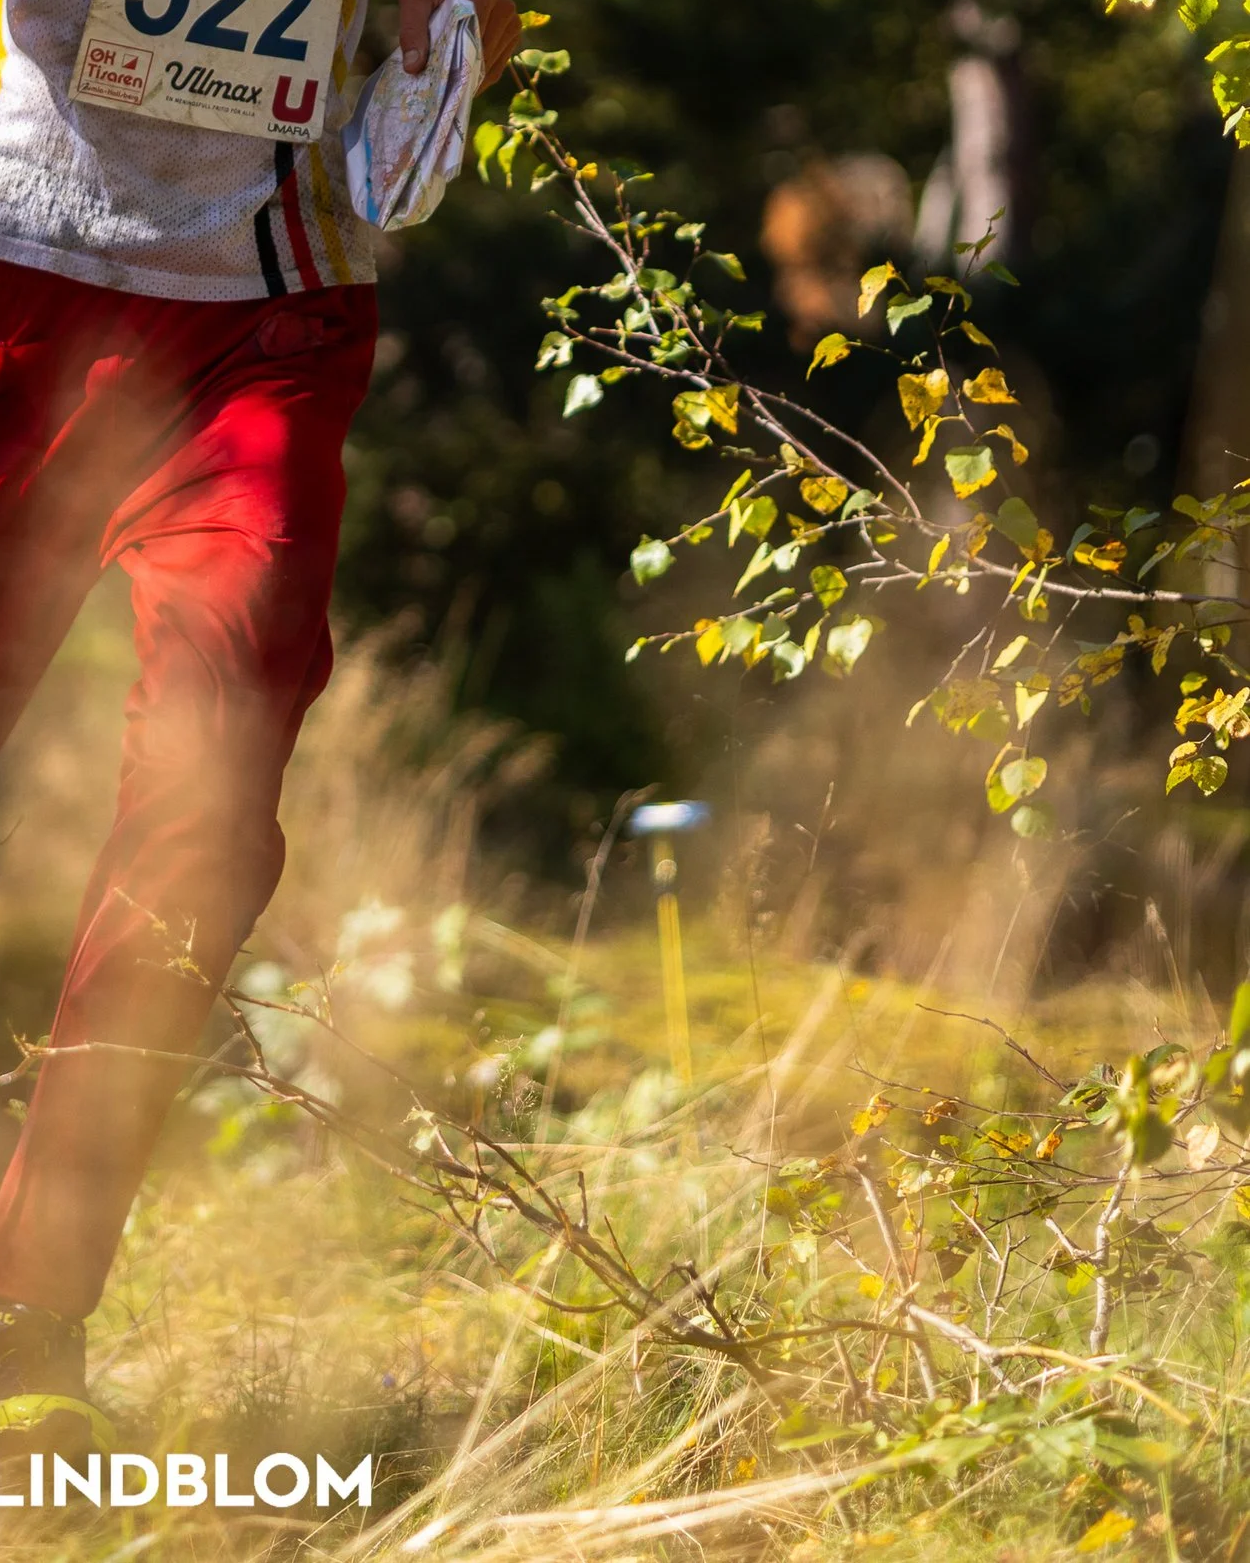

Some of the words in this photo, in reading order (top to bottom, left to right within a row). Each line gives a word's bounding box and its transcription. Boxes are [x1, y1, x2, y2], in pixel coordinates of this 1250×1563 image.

[87, 63, 143, 89] Tisaren
[165, 61, 262, 105] Ullmax
[271, 75, 319, 124] U
[267, 122, 311, 139] UMARA
